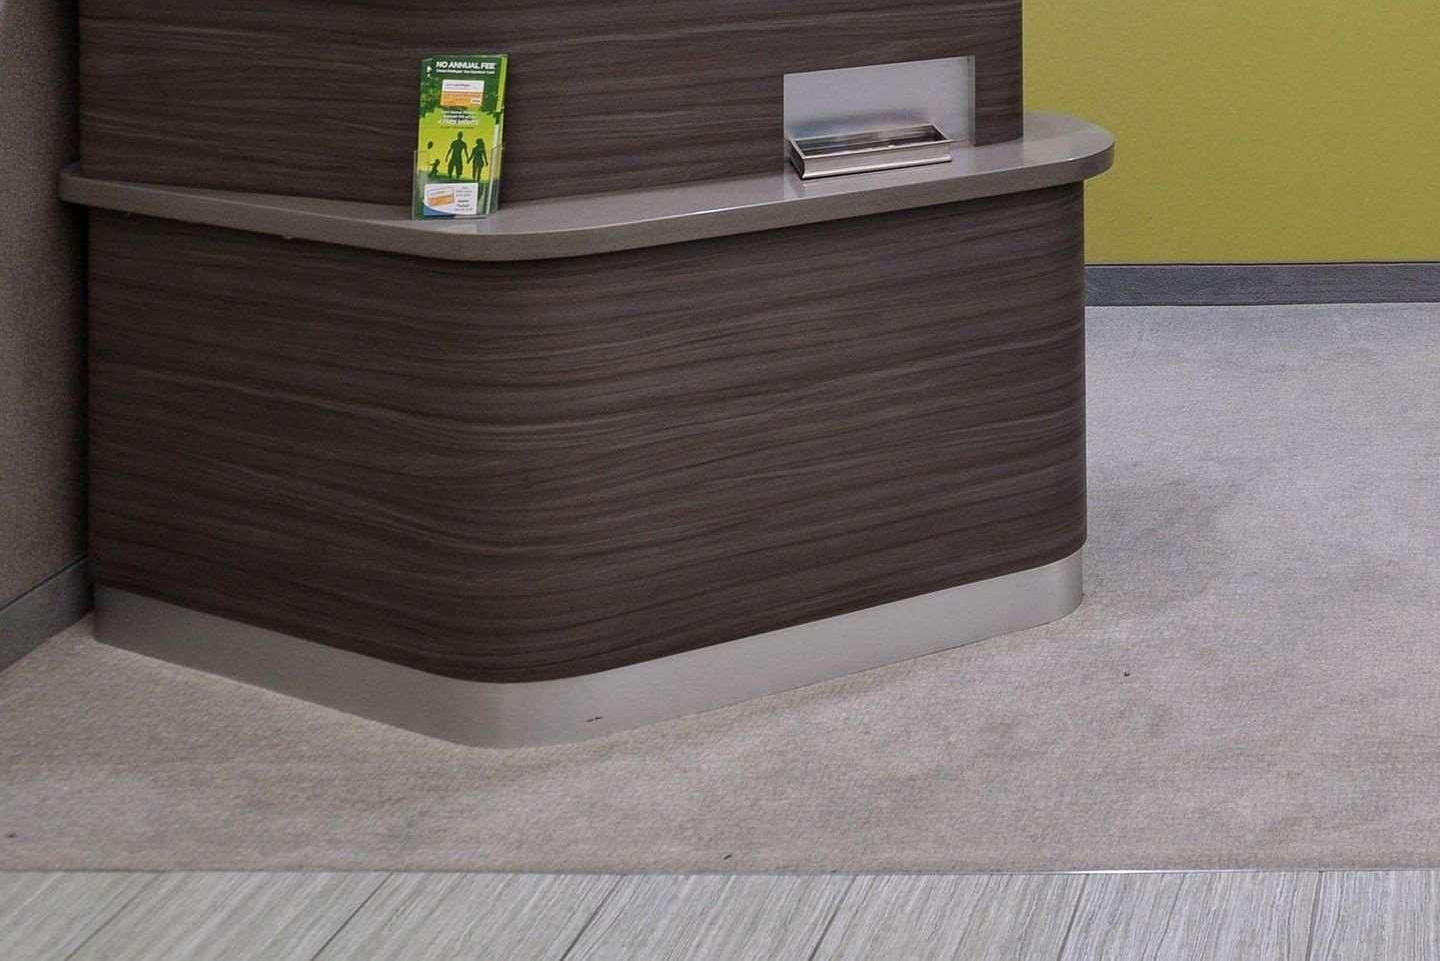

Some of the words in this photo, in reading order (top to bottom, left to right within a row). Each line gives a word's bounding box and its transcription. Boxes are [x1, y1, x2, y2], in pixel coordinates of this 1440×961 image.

[436, 61, 448, 69] NO
[448, 61, 480, 69] ANNUAL
[481, 62, 496, 70] FEE
